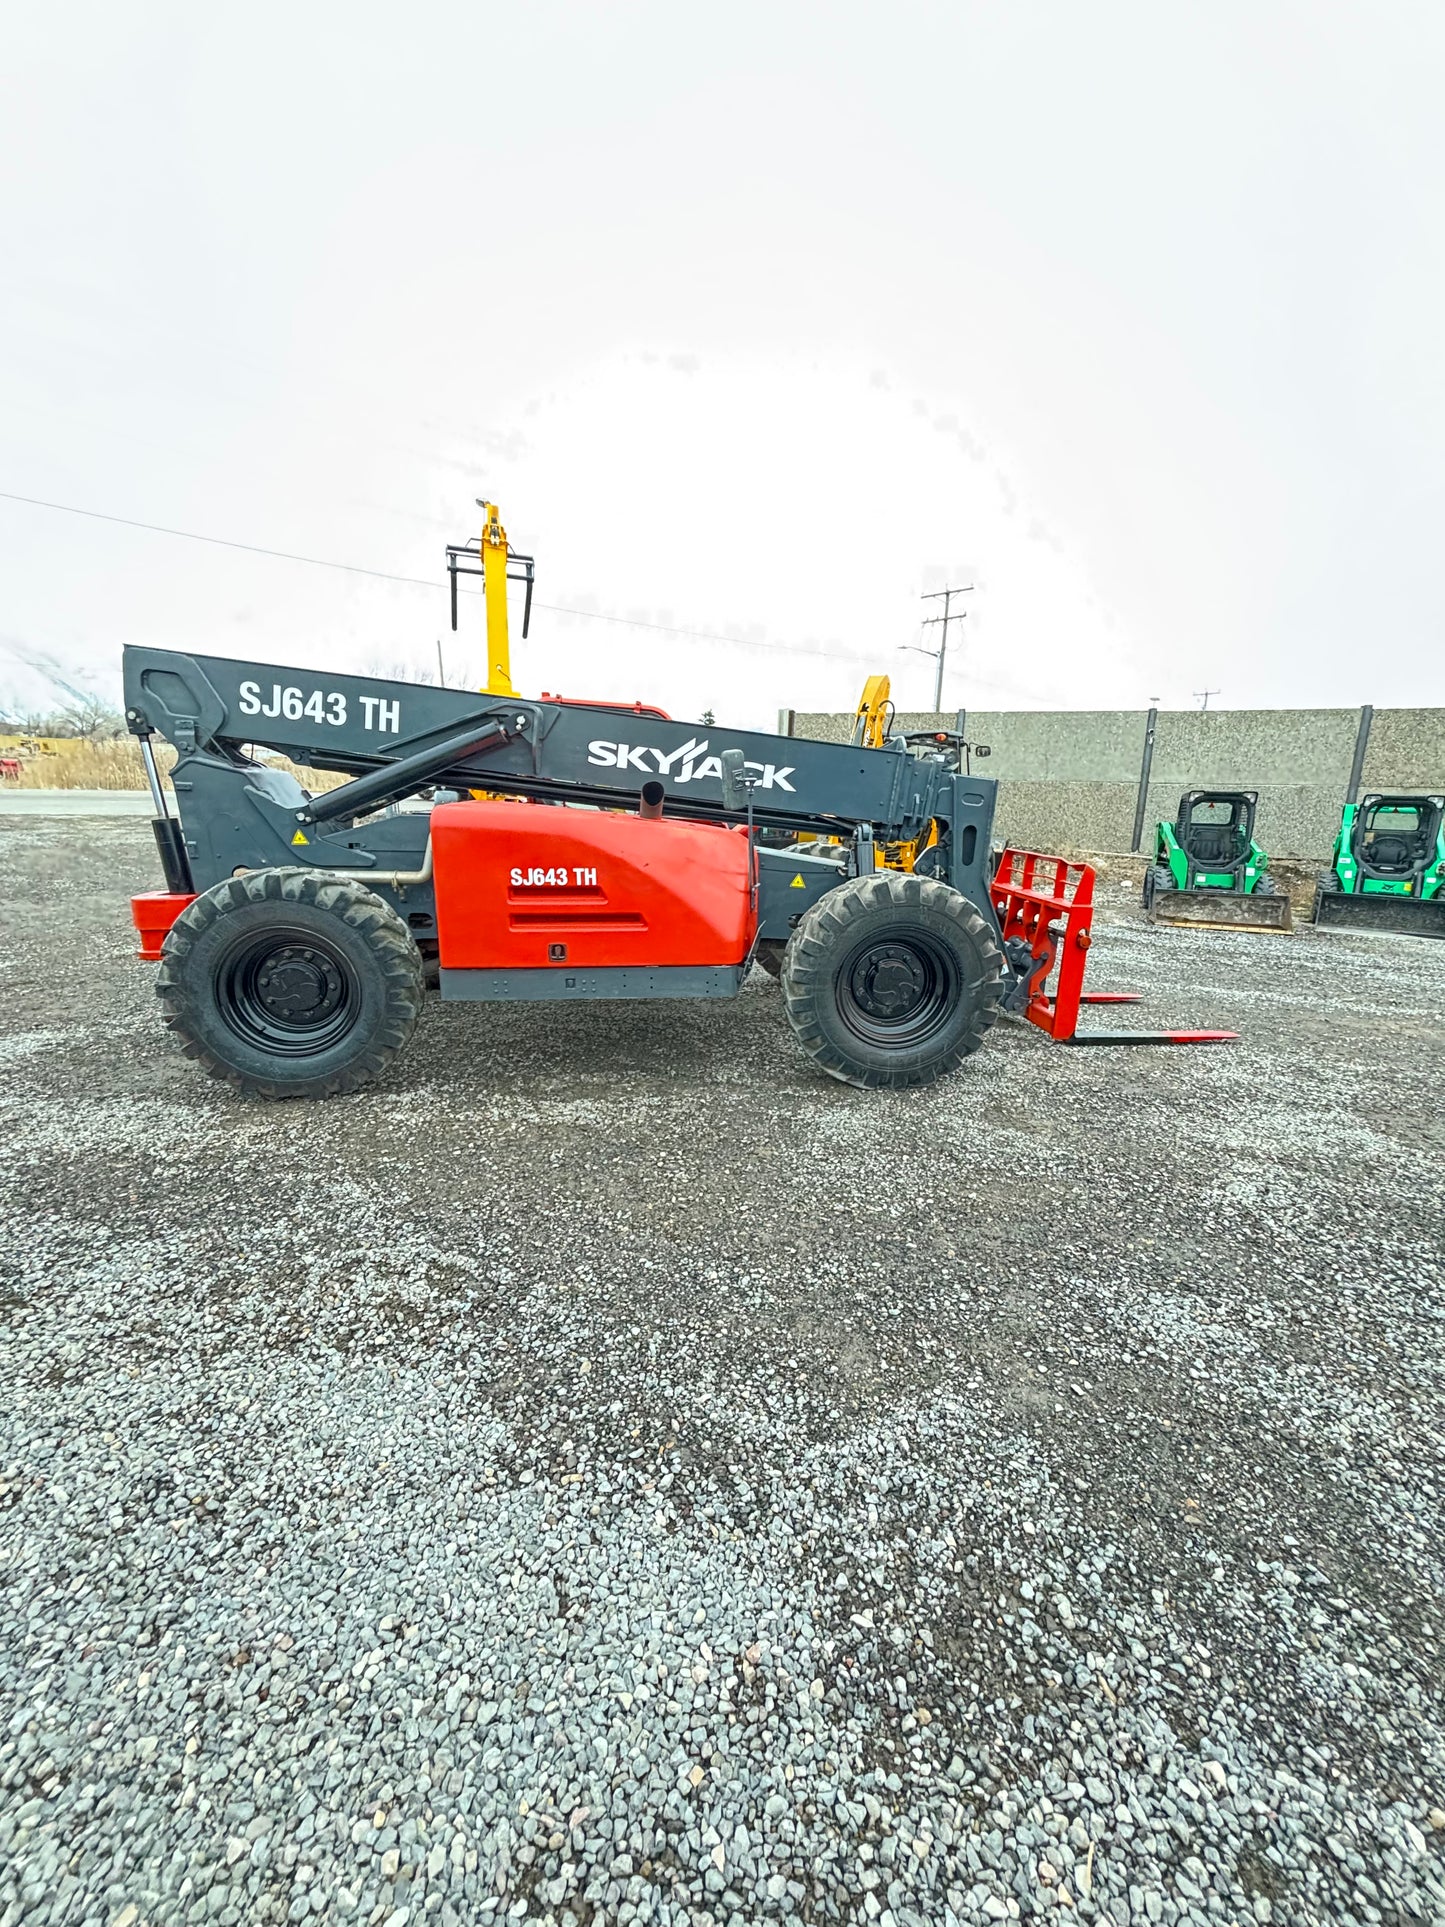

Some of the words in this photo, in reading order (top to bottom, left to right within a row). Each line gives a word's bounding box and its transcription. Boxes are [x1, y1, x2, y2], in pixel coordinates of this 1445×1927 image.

[239, 681, 347, 726] SJ643
[359, 696, 400, 733] TH
[510, 868, 568, 886] SJ643
[573, 868, 597, 886] TH
